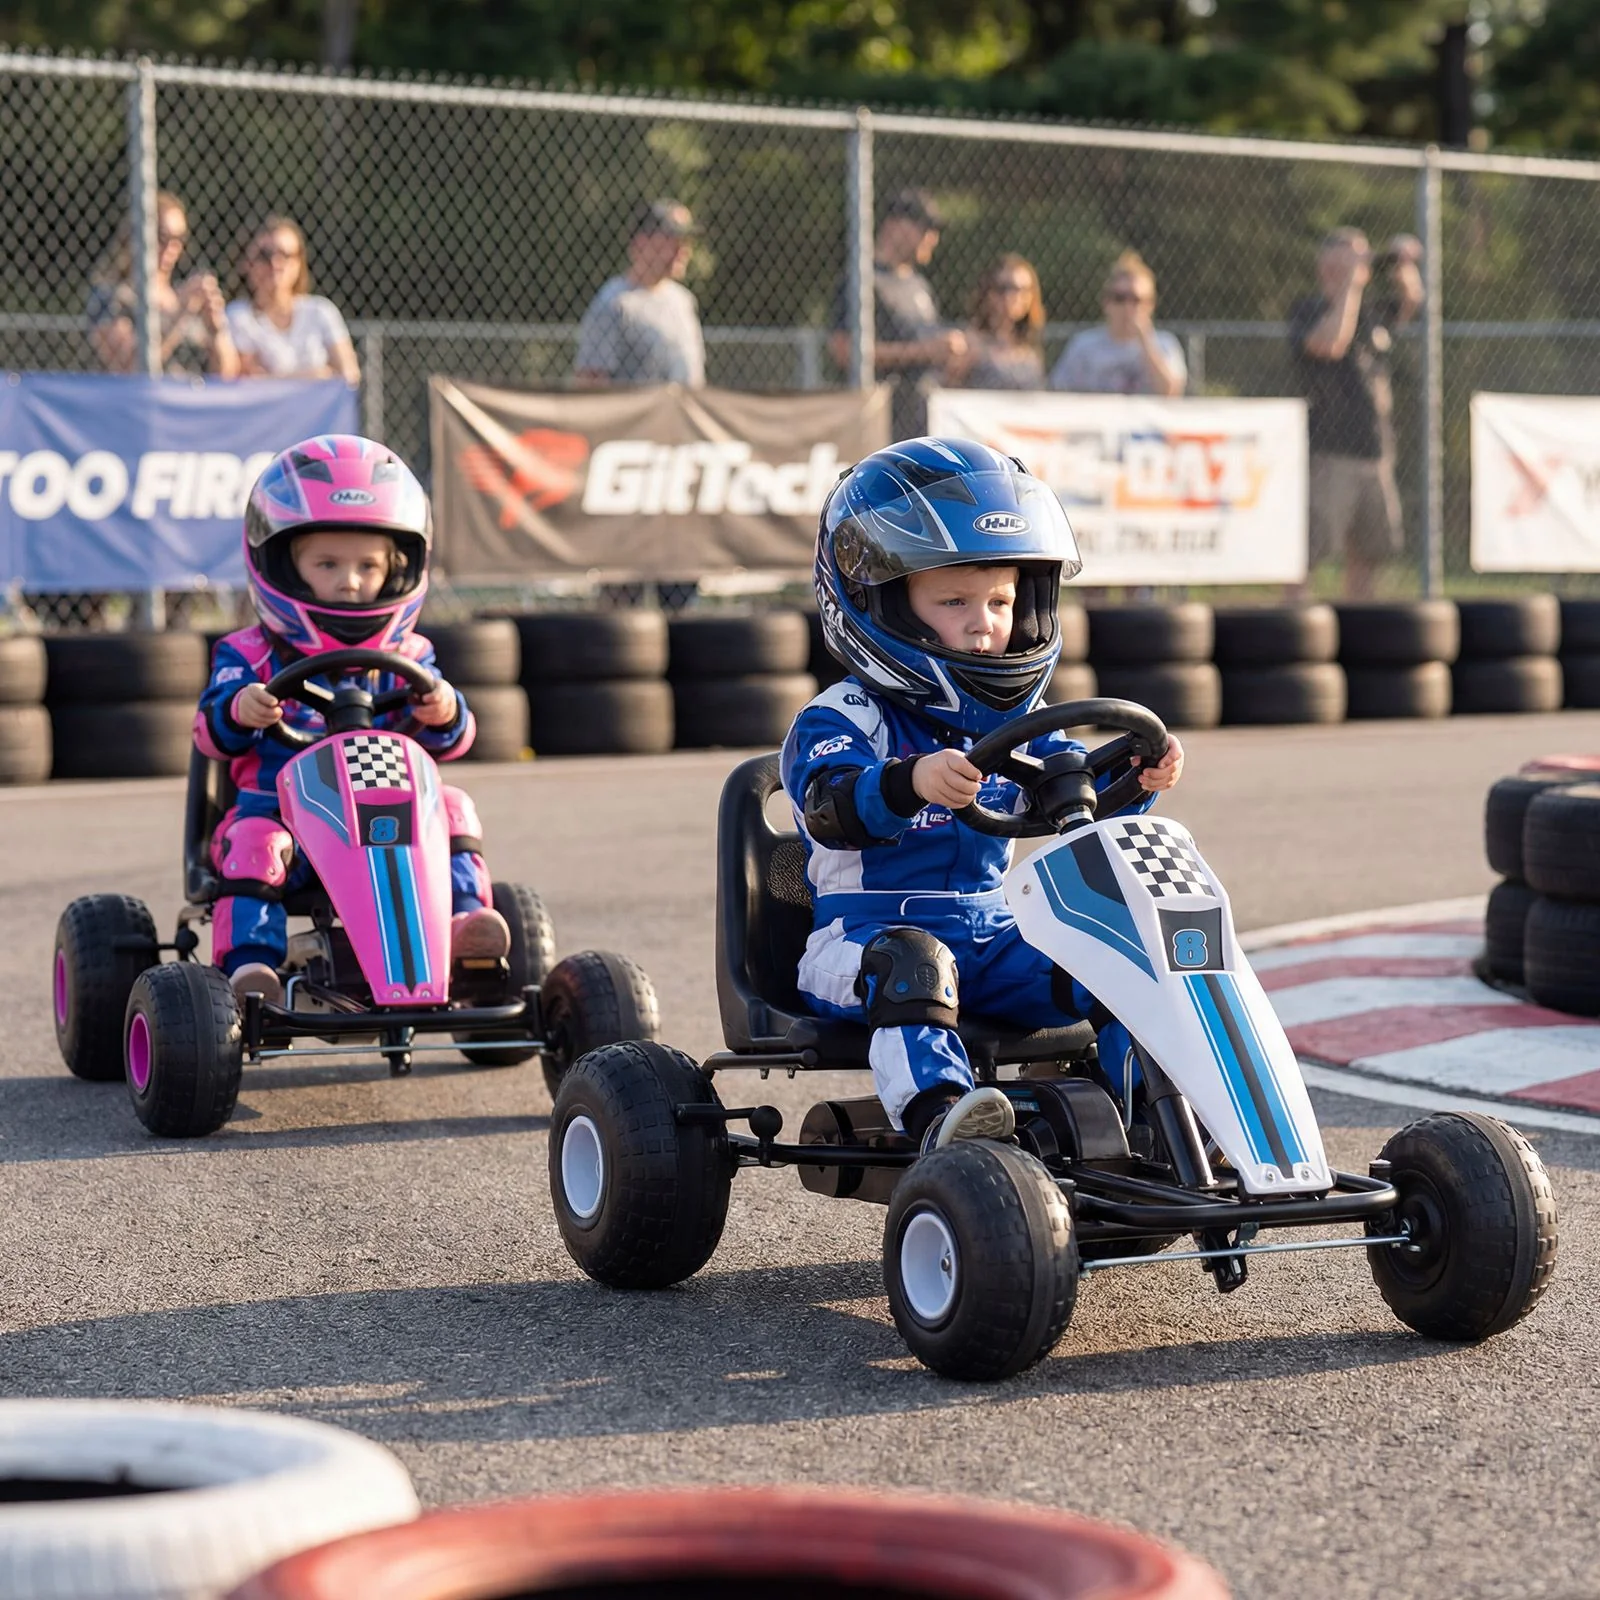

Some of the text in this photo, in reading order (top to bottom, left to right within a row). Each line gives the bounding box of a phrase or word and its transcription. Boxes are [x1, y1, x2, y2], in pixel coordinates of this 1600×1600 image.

[984, 517, 1023, 529] HJC
[369, 815, 399, 844] 8
[1173, 928, 1208, 967] 8
